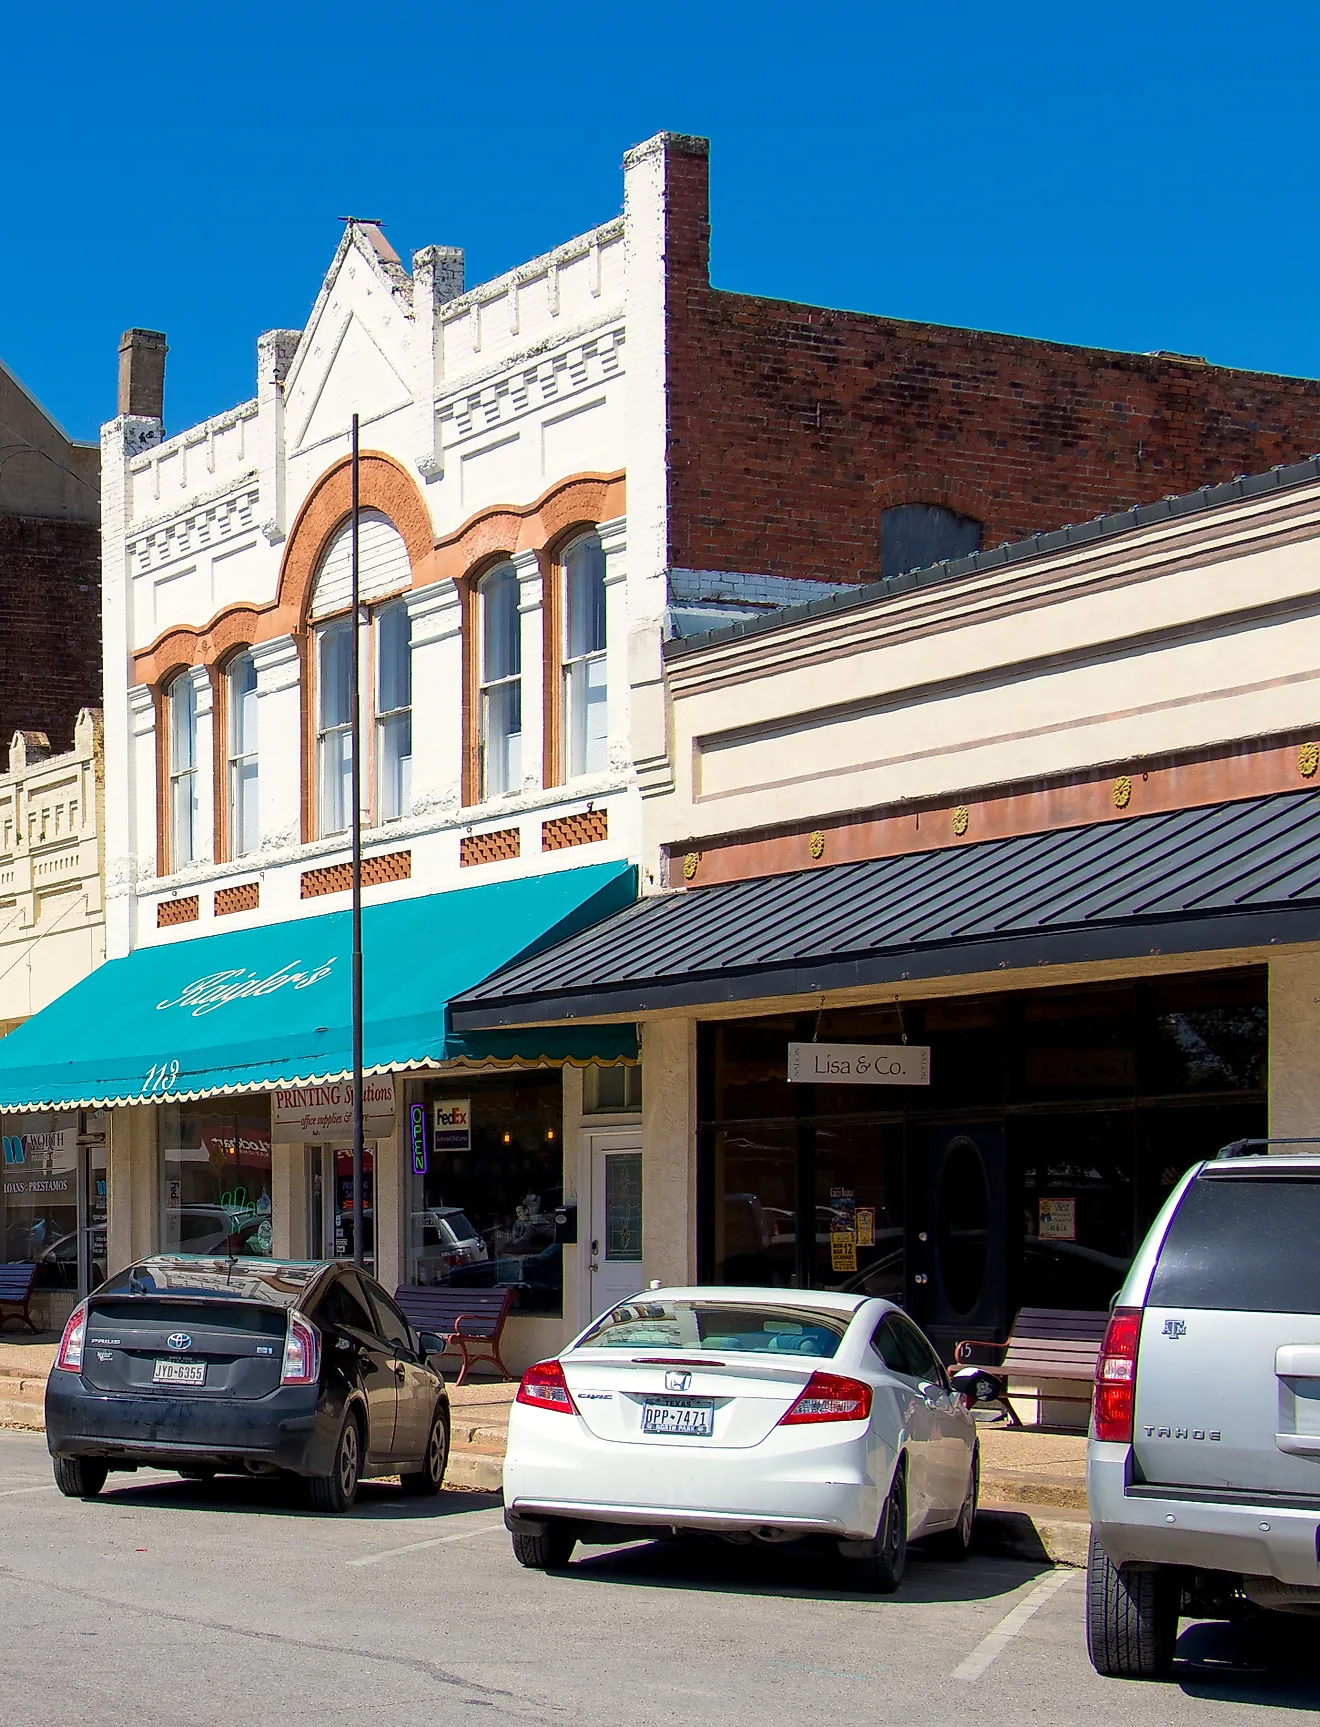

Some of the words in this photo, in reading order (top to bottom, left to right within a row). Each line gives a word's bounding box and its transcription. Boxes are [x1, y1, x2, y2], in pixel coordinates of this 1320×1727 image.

[814, 1054, 851, 1074] Lisa
[856, 1055, 871, 1074] &
[874, 1056, 906, 1075] Co.
[142, 1059, 180, 1091] 113
[275, 1085, 341, 1109] PRINTING
[317, 1112, 342, 1128] supplies
[437, 1107, 467, 1125] FedEx
[30, 1132, 64, 1150] WORTH
[413, 1108, 424, 1170] OPEN
[3, 1181, 25, 1193] LOANS
[28, 1180, 68, 1192] PRESTAMOS
[843, 1243, 853, 1255] 12
[665, 1400, 692, 1408] TEXAS
[1143, 1425, 1222, 1441] TAHOE
